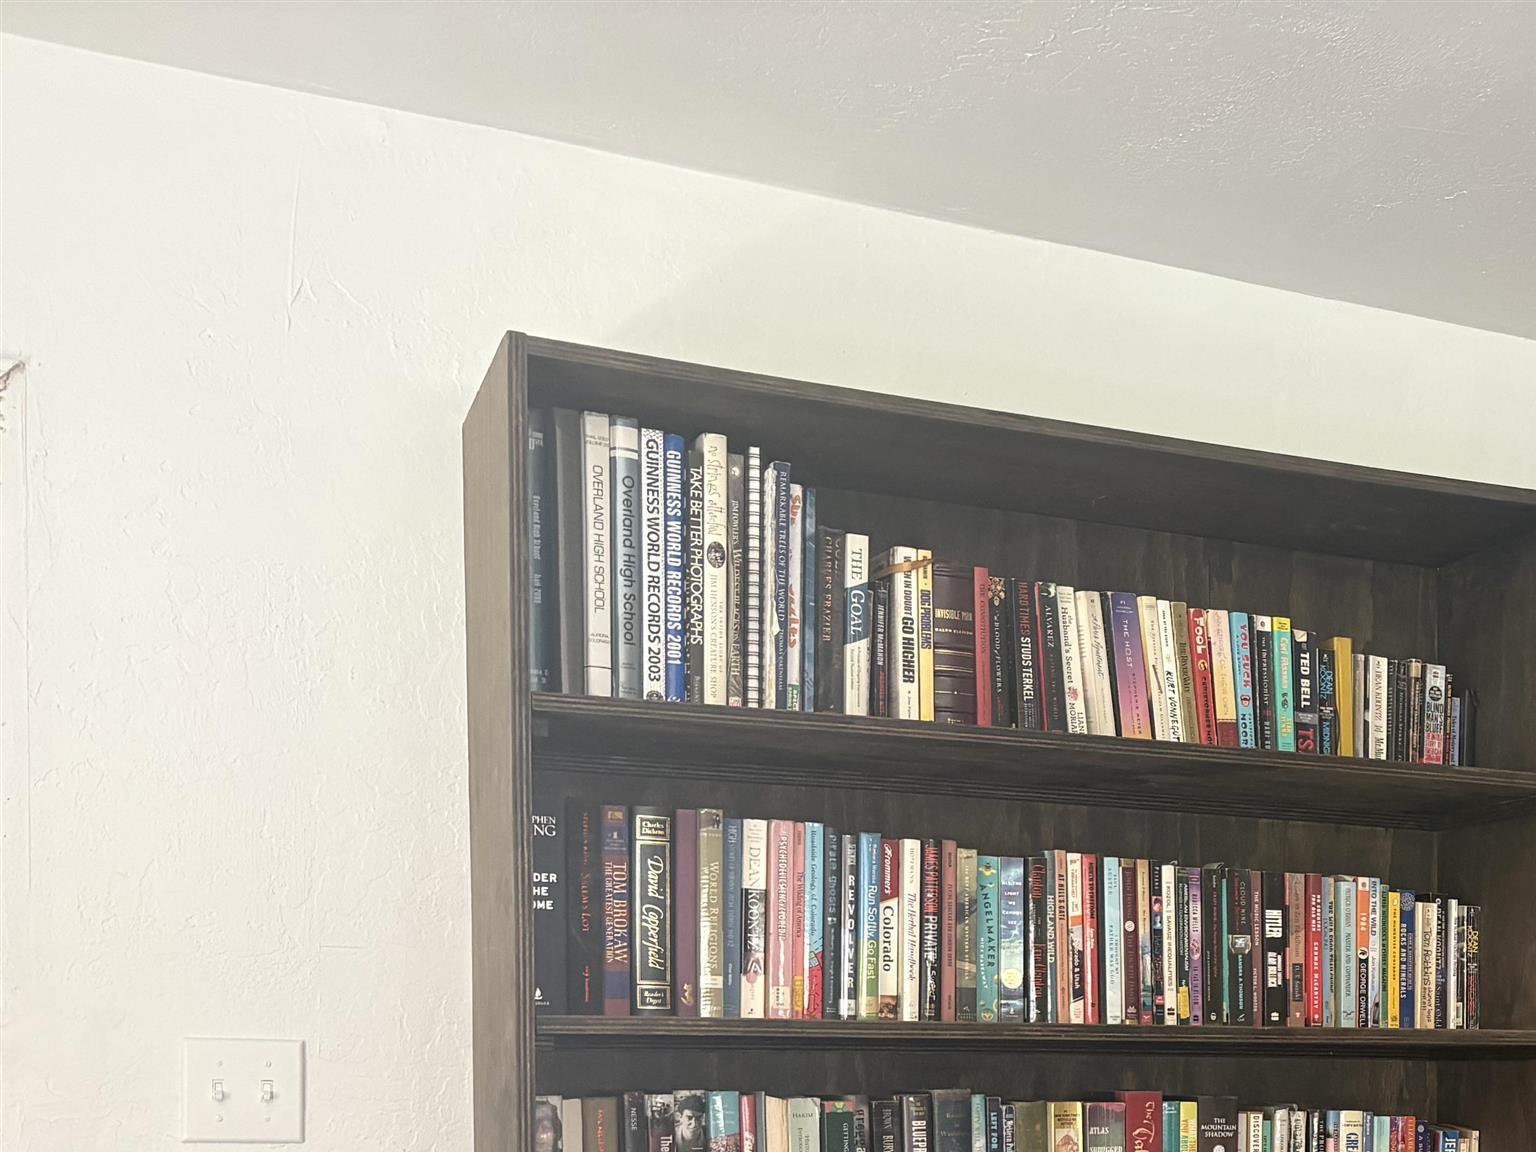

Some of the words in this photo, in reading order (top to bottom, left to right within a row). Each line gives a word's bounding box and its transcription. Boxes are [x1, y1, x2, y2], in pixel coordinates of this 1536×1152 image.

[646, 438, 659, 514] GUINNESS
[667, 449, 681, 515] GUINNESS
[690, 464, 701, 499] TAKE
[592, 465, 605, 530] OVERLAND
[622, 475, 636, 548] Overland
[690, 500, 702, 546] BETTER
[593, 533, 605, 561] HIGH
[647, 517, 660, 570] WORLD
[667, 520, 681, 566] WORLD
[619, 553, 637, 588] High
[852, 547, 864, 581] THE
[593, 565, 604, 614] SCHOOL
[667, 570, 681, 629] RECORDS
[690, 548, 703, 646] PHOTOGRAPHS
[920, 589, 931, 606] DOG
[1018, 582, 1029, 607] HARD
[623, 592, 638, 645] School
[648, 574, 660, 643] RECORDS
[850, 589, 866, 637] GOAL
[1020, 606, 1030, 636] TIMES
[920, 606, 931, 650] PROBLEMS
[1194, 616, 1204, 655] FOOL
[649, 647, 660, 682] 2003
[668, 634, 681, 664] 2001
[1020, 636, 1033, 666] STUDS
[1300, 651, 1310, 676] TED
[1022, 667, 1034, 702] TERKEL
[1300, 678, 1311, 709] BELL
[612, 861, 628, 894] TOM
[646, 855, 665, 900] David
[748, 846, 762, 888] DEAN
[871, 884, 880, 905] Run
[1370, 880, 1378, 900] INTO
[746, 889, 761, 949] KOONTZ
[1265, 909, 1283, 939] HITLER
[1370, 900, 1378, 916] THE
[612, 898, 628, 963] BROKAW
[641, 903, 666, 971] Copperfield
[882, 904, 896, 972] Colorado
[1370, 916, 1378, 937] WILD
[1400, 923, 1408, 946] ROCKS
[1423, 930, 1433, 948] Tom
[869, 940, 879, 955] Go
[1400, 948, 1408, 963] AND
[868, 956, 879, 980] Fast
[1400, 964, 1408, 999] MINERALS
[1422, 949, 1433, 987] Robbins
[990, 1111, 999, 1130] LEFT
[659, 1134, 674, 1152] The
[991, 1131, 999, 1149] FOR
